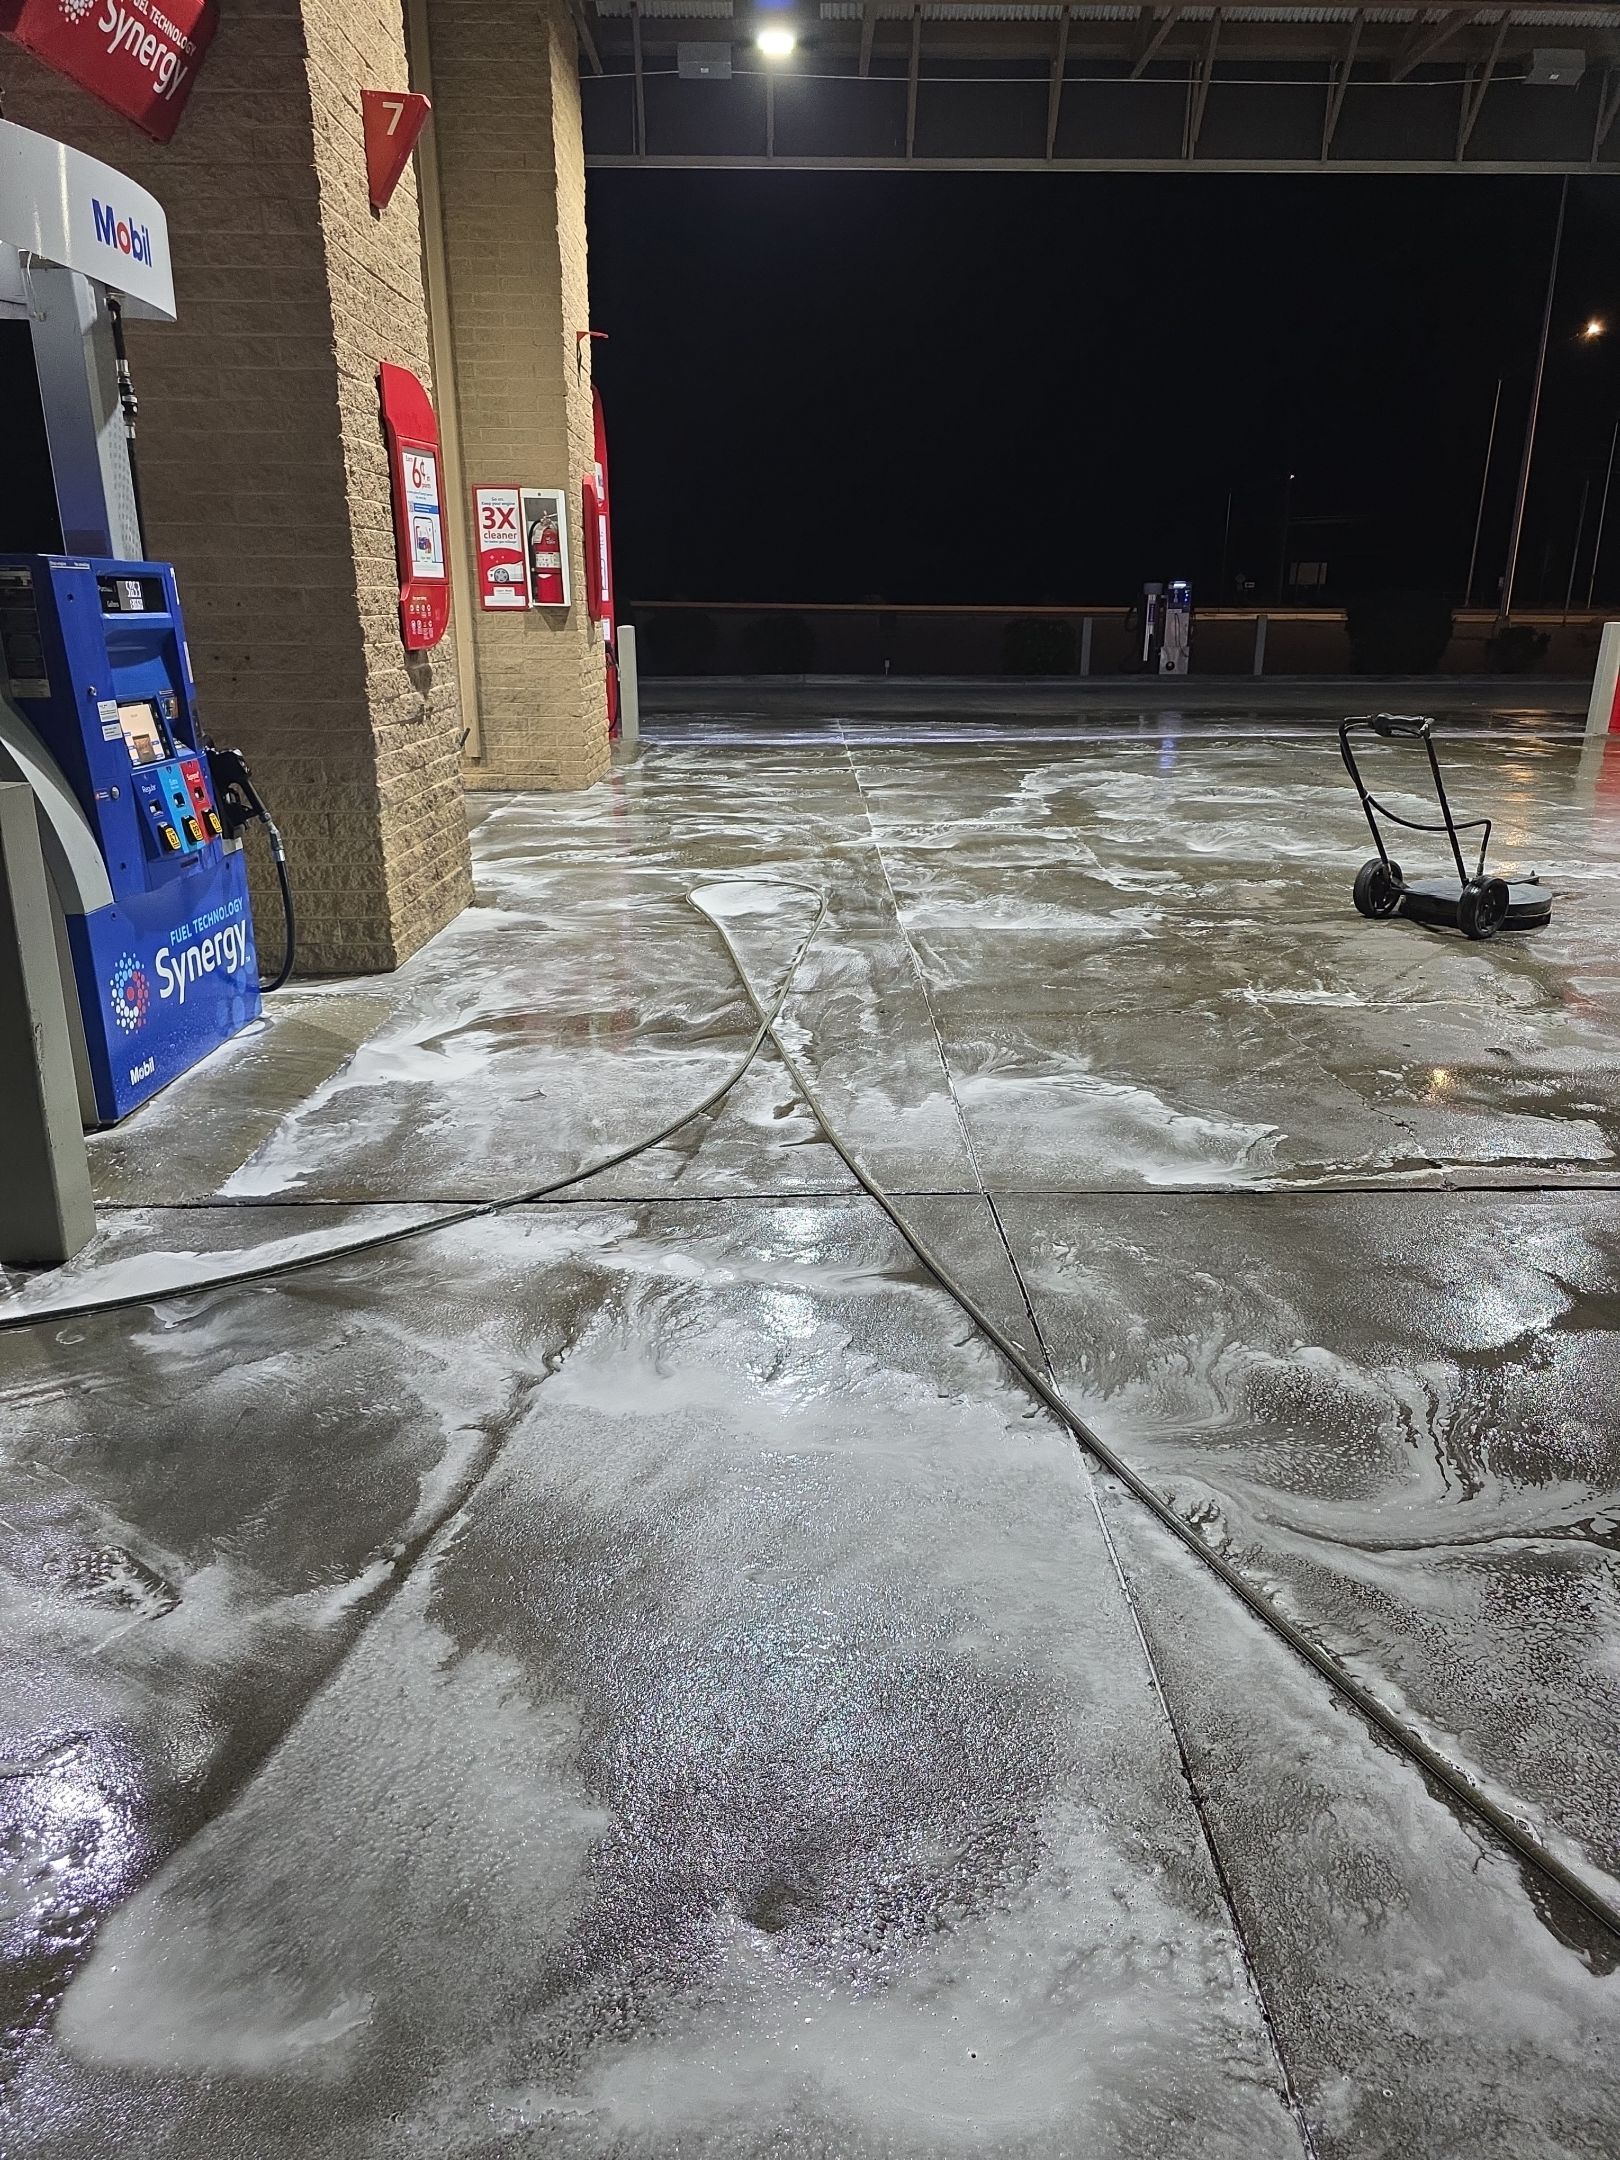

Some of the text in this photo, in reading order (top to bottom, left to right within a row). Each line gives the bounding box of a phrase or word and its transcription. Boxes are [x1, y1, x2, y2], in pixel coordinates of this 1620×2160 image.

[98, 0, 188, 100] Synergy
[149, 5, 197, 56] TECHNOLOGY
[382, 101, 404, 136] 7
[92, 198, 152, 268] Mobil
[482, 506, 517, 530] 3X
[483, 531, 518, 540] cleaner
[141, 784, 157, 795] Regular
[170, 896, 243, 947] FUEL TECHNOLOGY
[155, 919, 246, 1005] Synergy
[130, 1056, 155, 1086] Mobil
